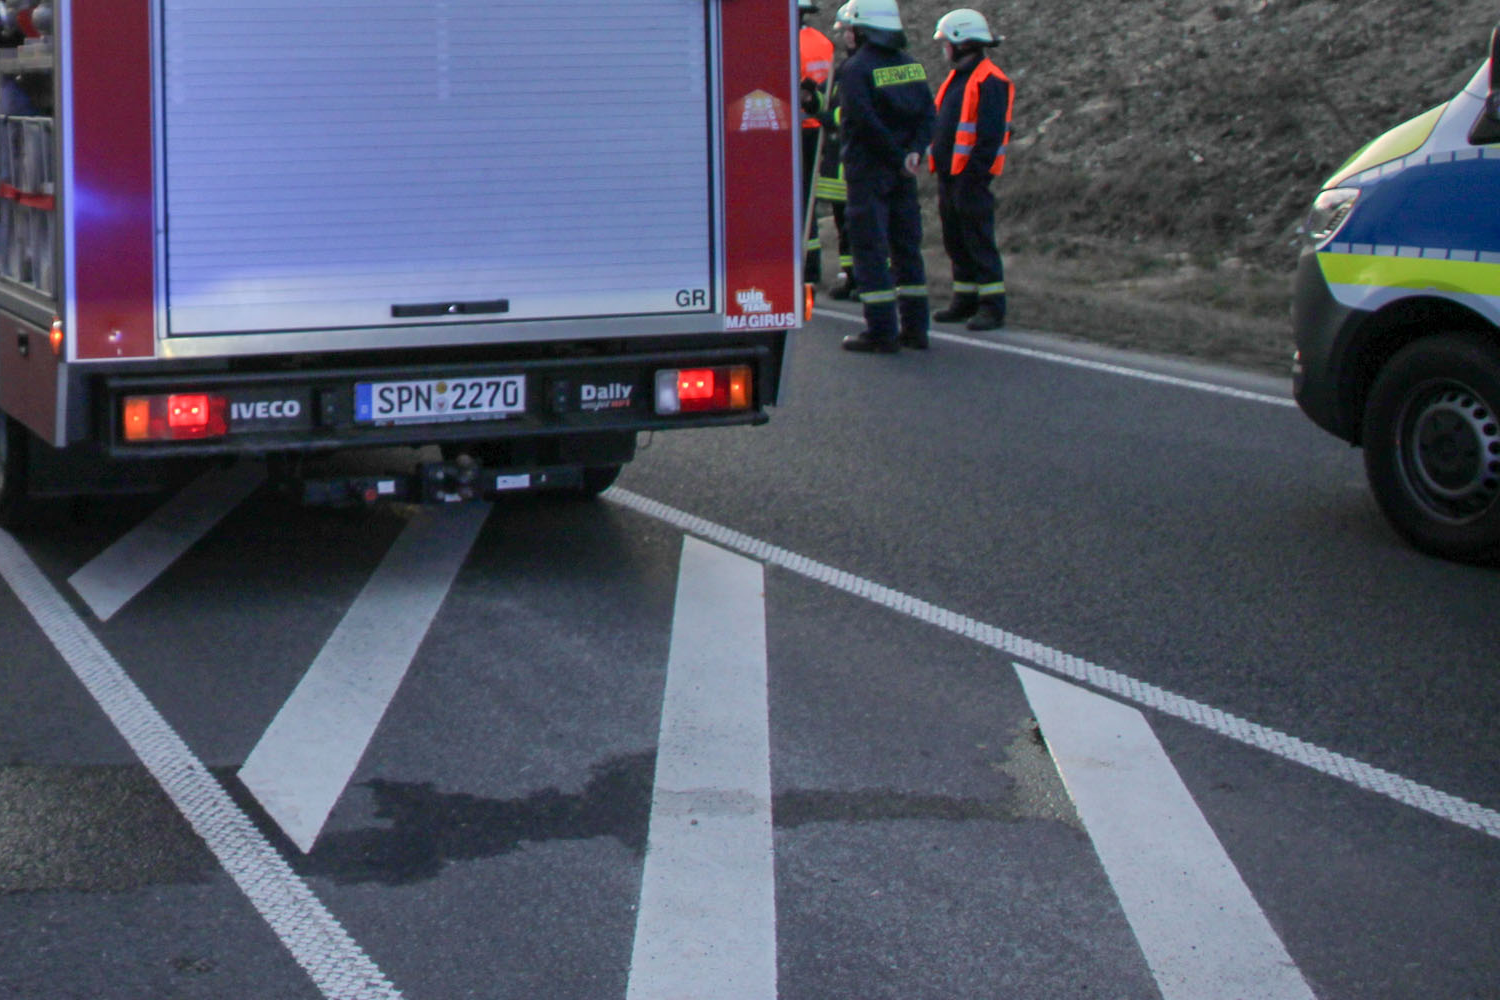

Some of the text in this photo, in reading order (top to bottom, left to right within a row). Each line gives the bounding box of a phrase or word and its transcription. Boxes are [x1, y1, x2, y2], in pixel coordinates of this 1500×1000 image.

[675, 289, 706, 308] GR
[725, 312, 796, 329] MAGIRUS
[378, 380, 519, 414] SPN 2270
[231, 400, 301, 420] IVECO
